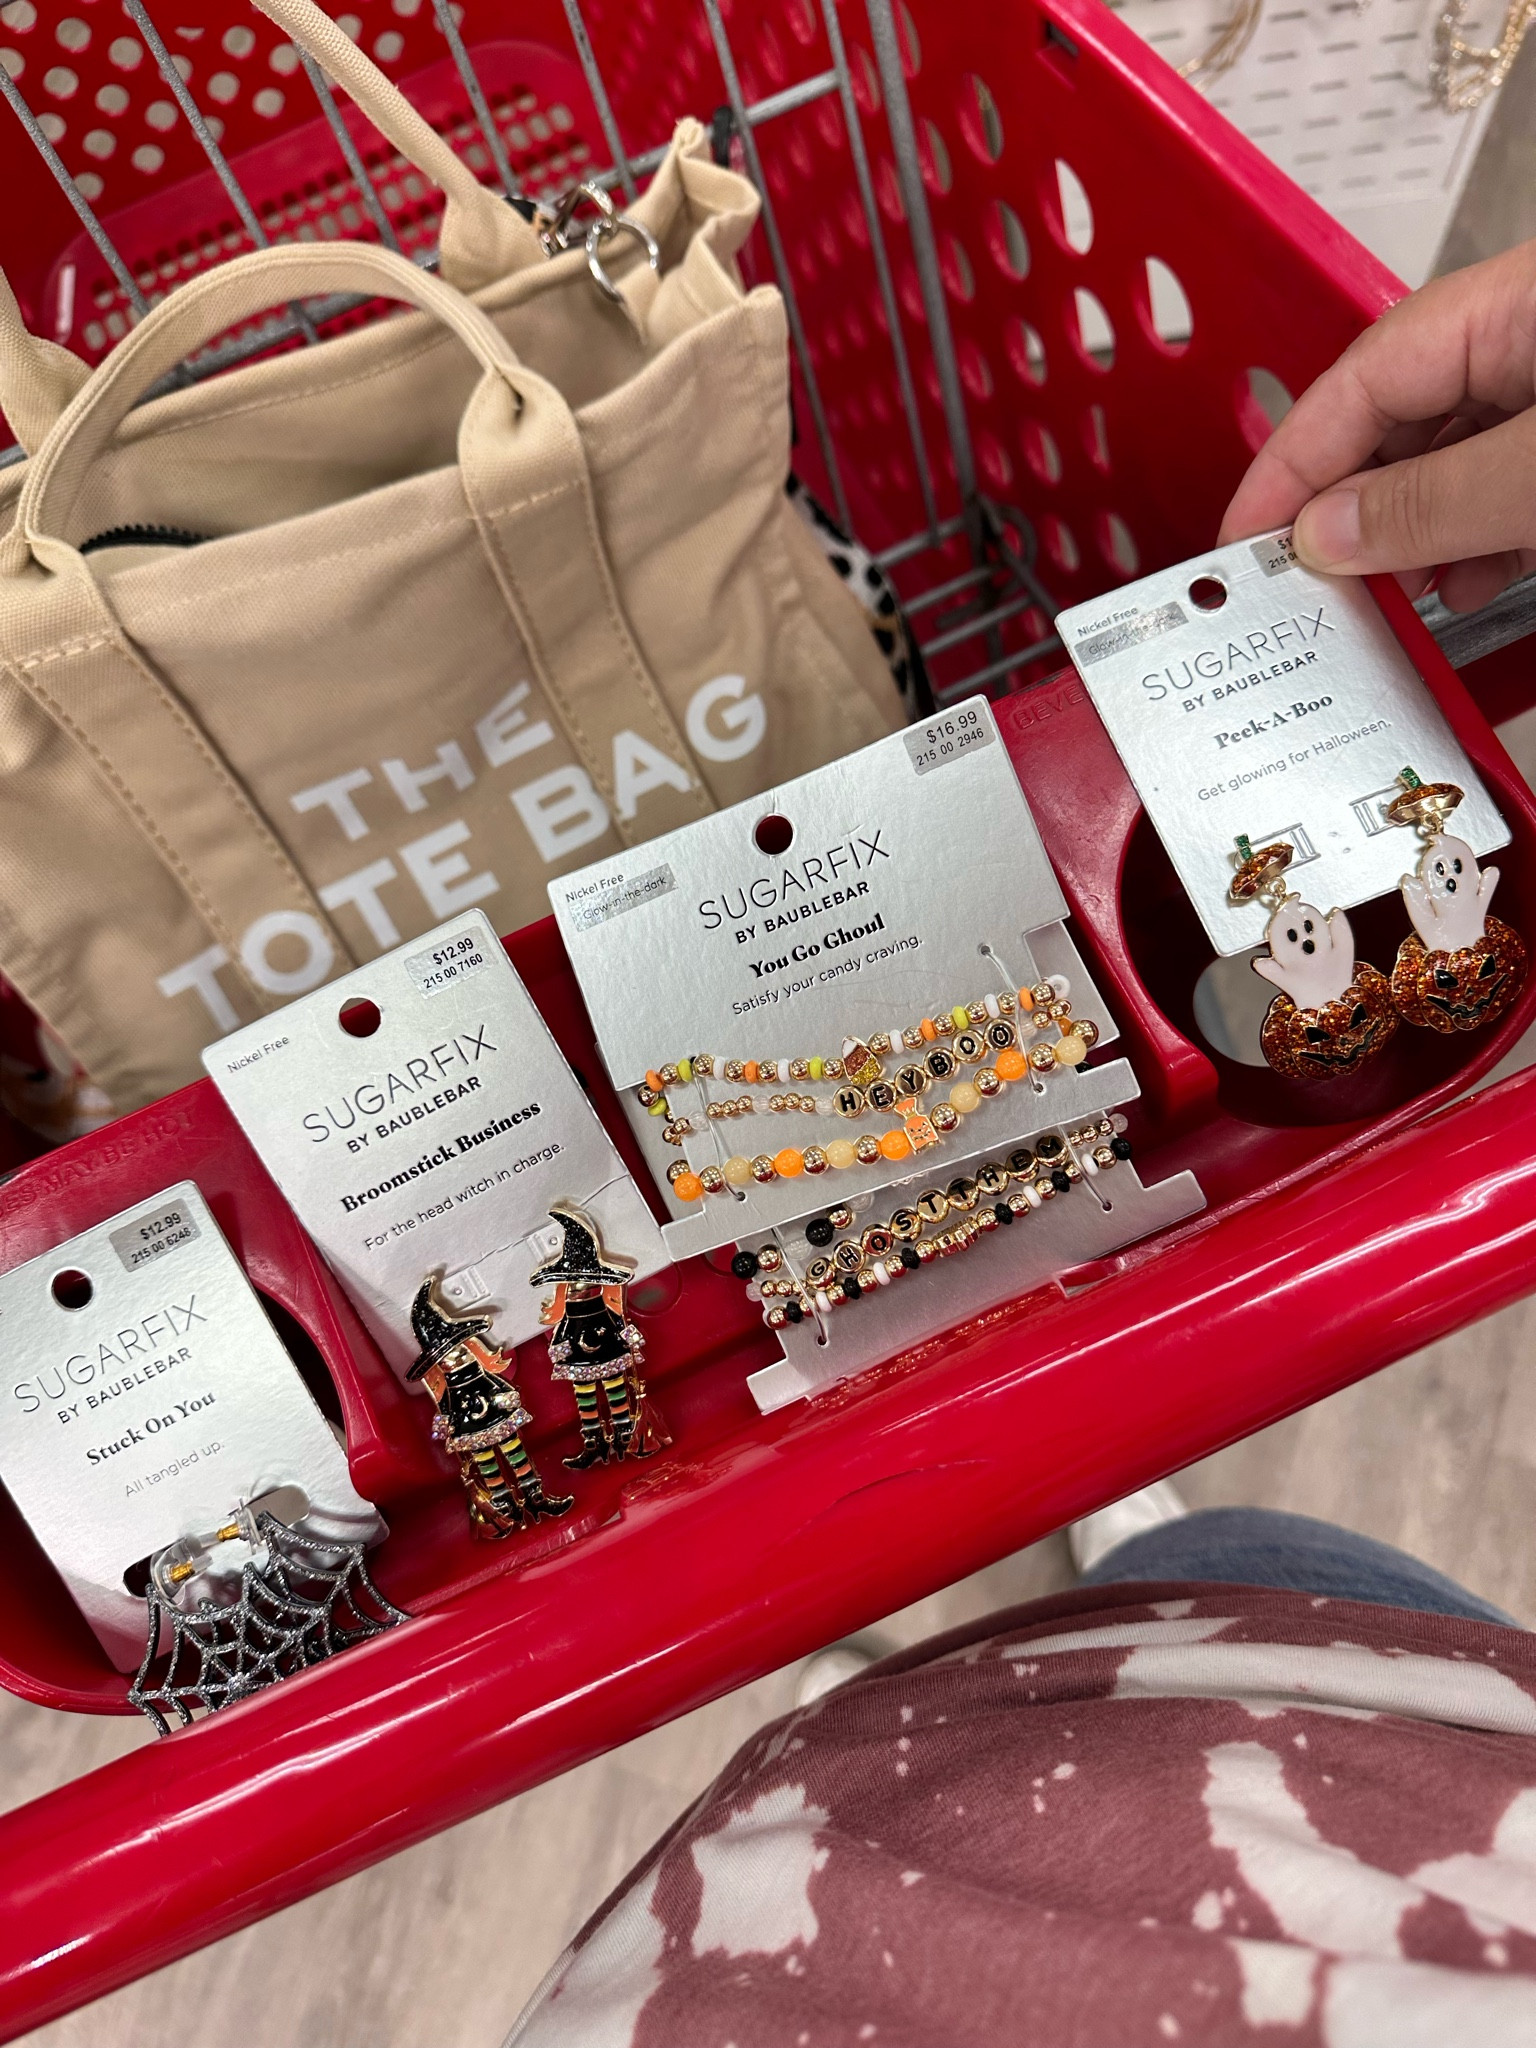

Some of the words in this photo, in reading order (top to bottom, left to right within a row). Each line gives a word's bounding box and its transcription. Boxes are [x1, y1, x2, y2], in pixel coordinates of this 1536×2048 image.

[1268, 555, 1287, 569] 215
[1277, 536, 1293, 550] $1
[1078, 614, 1112, 637] Nickel
[1113, 607, 1139, 623] Free
[1142, 608, 1334, 700] SUGARFIX
[1182, 694, 1204, 712] BY
[1212, 652, 1318, 700] BAUBLEBAR
[915, 749, 937, 768] 215
[939, 741, 954, 755] 00
[958, 728, 983, 747] 2946
[927, 711, 977, 743] $16.99
[1214, 697, 1332, 749] Peek-A-Boo
[292, 681, 555, 841] THE
[511, 674, 767, 863] BAG
[1198, 780, 1227, 801] Get
[1229, 760, 1287, 791] glowing
[1288, 750, 1309, 764] for
[1312, 721, 1392, 756] Halloween.
[566, 881, 599, 904] Nickel
[600, 874, 626, 890] Free
[582, 874, 667, 922] Glow-in-the-dark
[699, 830, 889, 929] SUGARFIX
[157, 820, 499, 1031] TOTE
[735, 925, 755, 944] BY
[764, 882, 869, 932] BAUBLEBAR
[424, 973, 443, 988] 215
[444, 966, 457, 978] 00
[457, 954, 482, 971] 7160
[433, 938, 473, 965] $12.99
[732, 990, 778, 1014] Satisfy
[783, 976, 813, 998] your
[819, 958, 860, 981] candy
[866, 936, 922, 963] craving.
[749, 956, 789, 978] You
[792, 945, 820, 961] Go
[823, 913, 884, 949] Ghoul
[227, 1049, 263, 1073] Nickel
[263, 1037, 289, 1054] Free
[303, 1025, 497, 1142] SUGARFIX
[347, 1133, 369, 1153] BY
[375, 1077, 481, 1138] BAUBLEBAR
[340, 1146, 457, 1212] Broomstick
[454, 1104, 540, 1153] Business
[140, 1213, 181, 1240] $12.99
[363, 1231, 389, 1250] For
[391, 1220, 416, 1236] the
[417, 1197, 453, 1222] head
[456, 1178, 494, 1202] witch
[495, 1171, 511, 1182] in
[513, 1144, 564, 1173] charge.
[131, 1249, 151, 1264] 215
[152, 1240, 165, 1254] 00
[166, 1227, 192, 1246] 6248
[15, 1295, 207, 1412] SUGARFIX
[58, 1404, 79, 1424] BY
[86, 1348, 191, 1409] BAUBLEBAR
[87, 1429, 145, 1465] Stuck
[146, 1415, 175, 1433] On
[174, 1393, 215, 1418] You
[126, 1477, 145, 1498] All
[146, 1450, 201, 1488] tangled
[202, 1442, 226, 1459] up.
